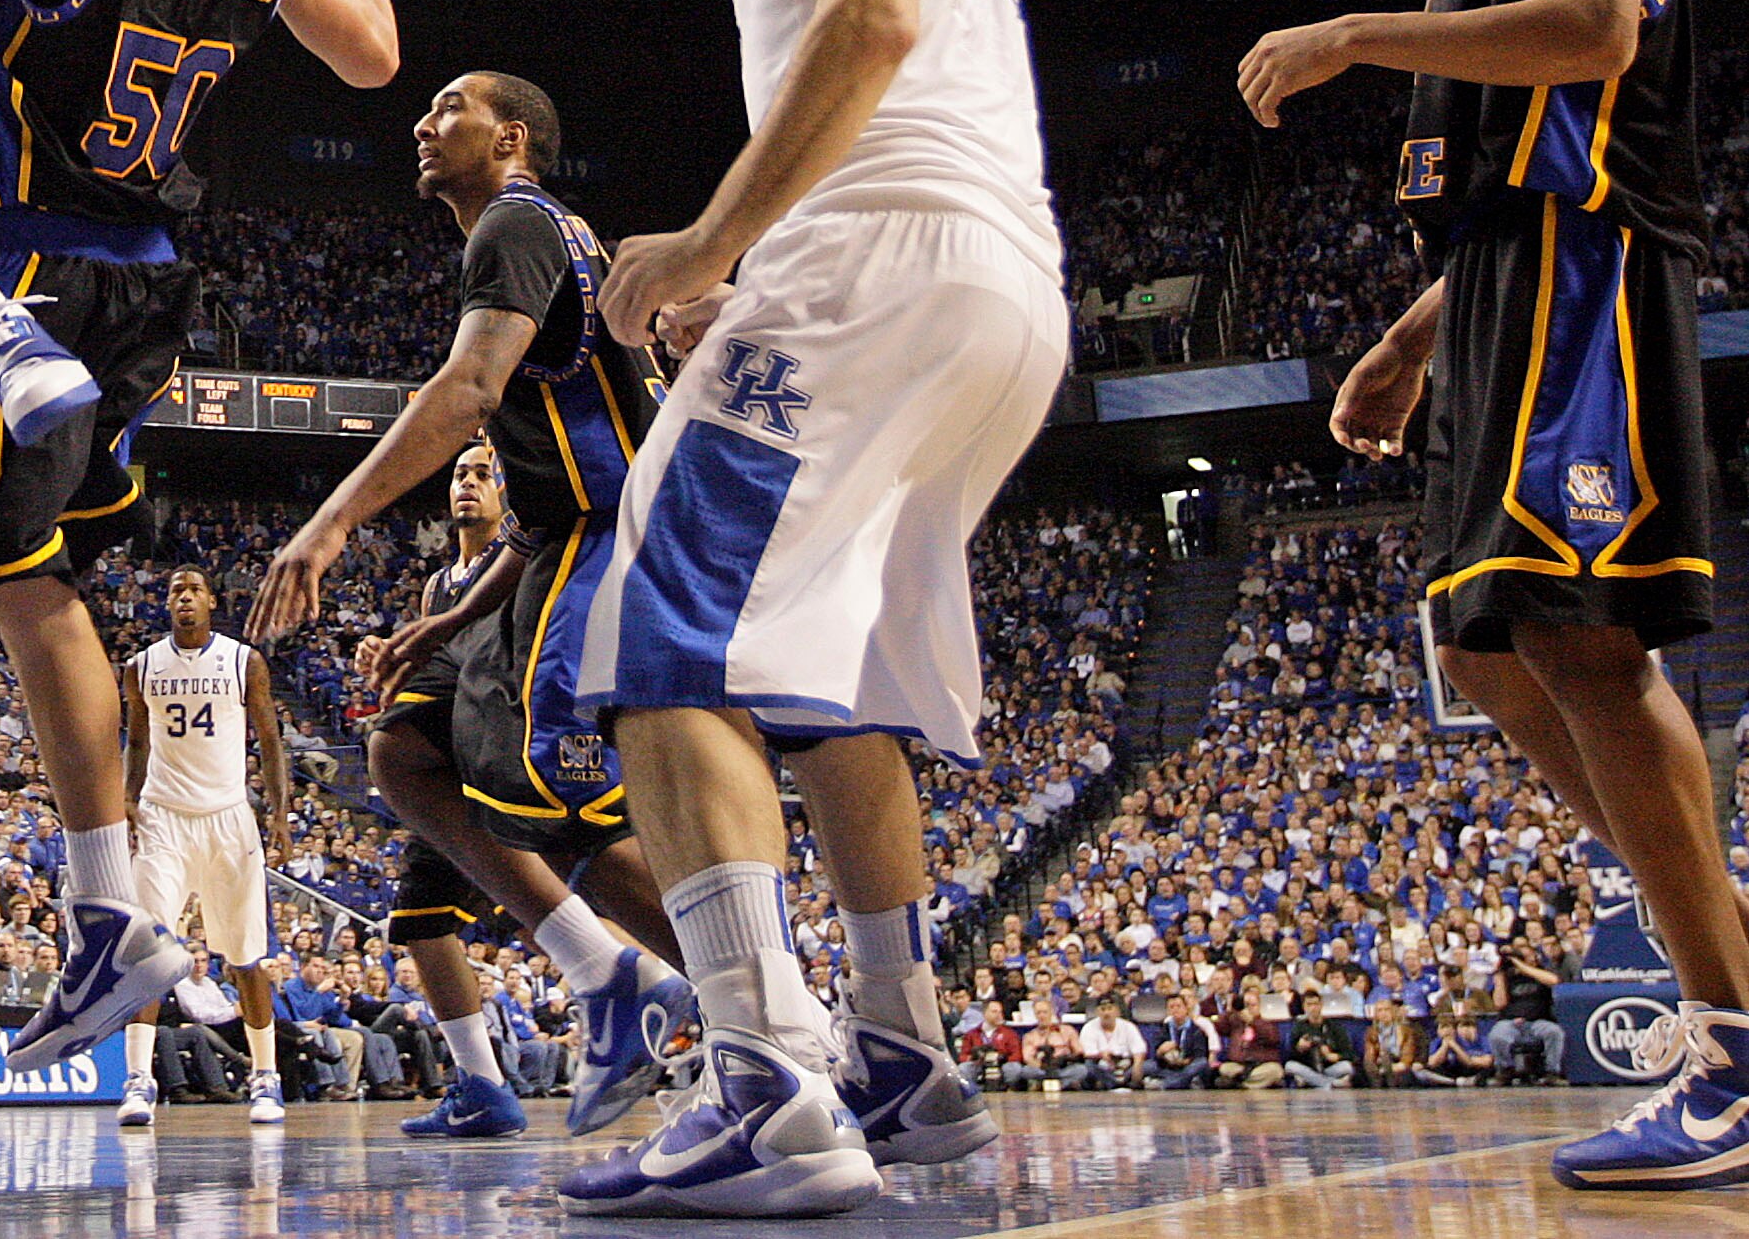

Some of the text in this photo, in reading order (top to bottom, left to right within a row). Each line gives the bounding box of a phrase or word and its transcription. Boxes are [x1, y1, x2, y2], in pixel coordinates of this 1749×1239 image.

[312, 138, 354, 161] 219
[262, 382, 318, 398] KENTUCKY
[196, 413, 226, 425] FOULS
[1569, 506, 1625, 523] EAGLES
[150, 677, 232, 697] KENTUCKY
[165, 701, 216, 738] 34
